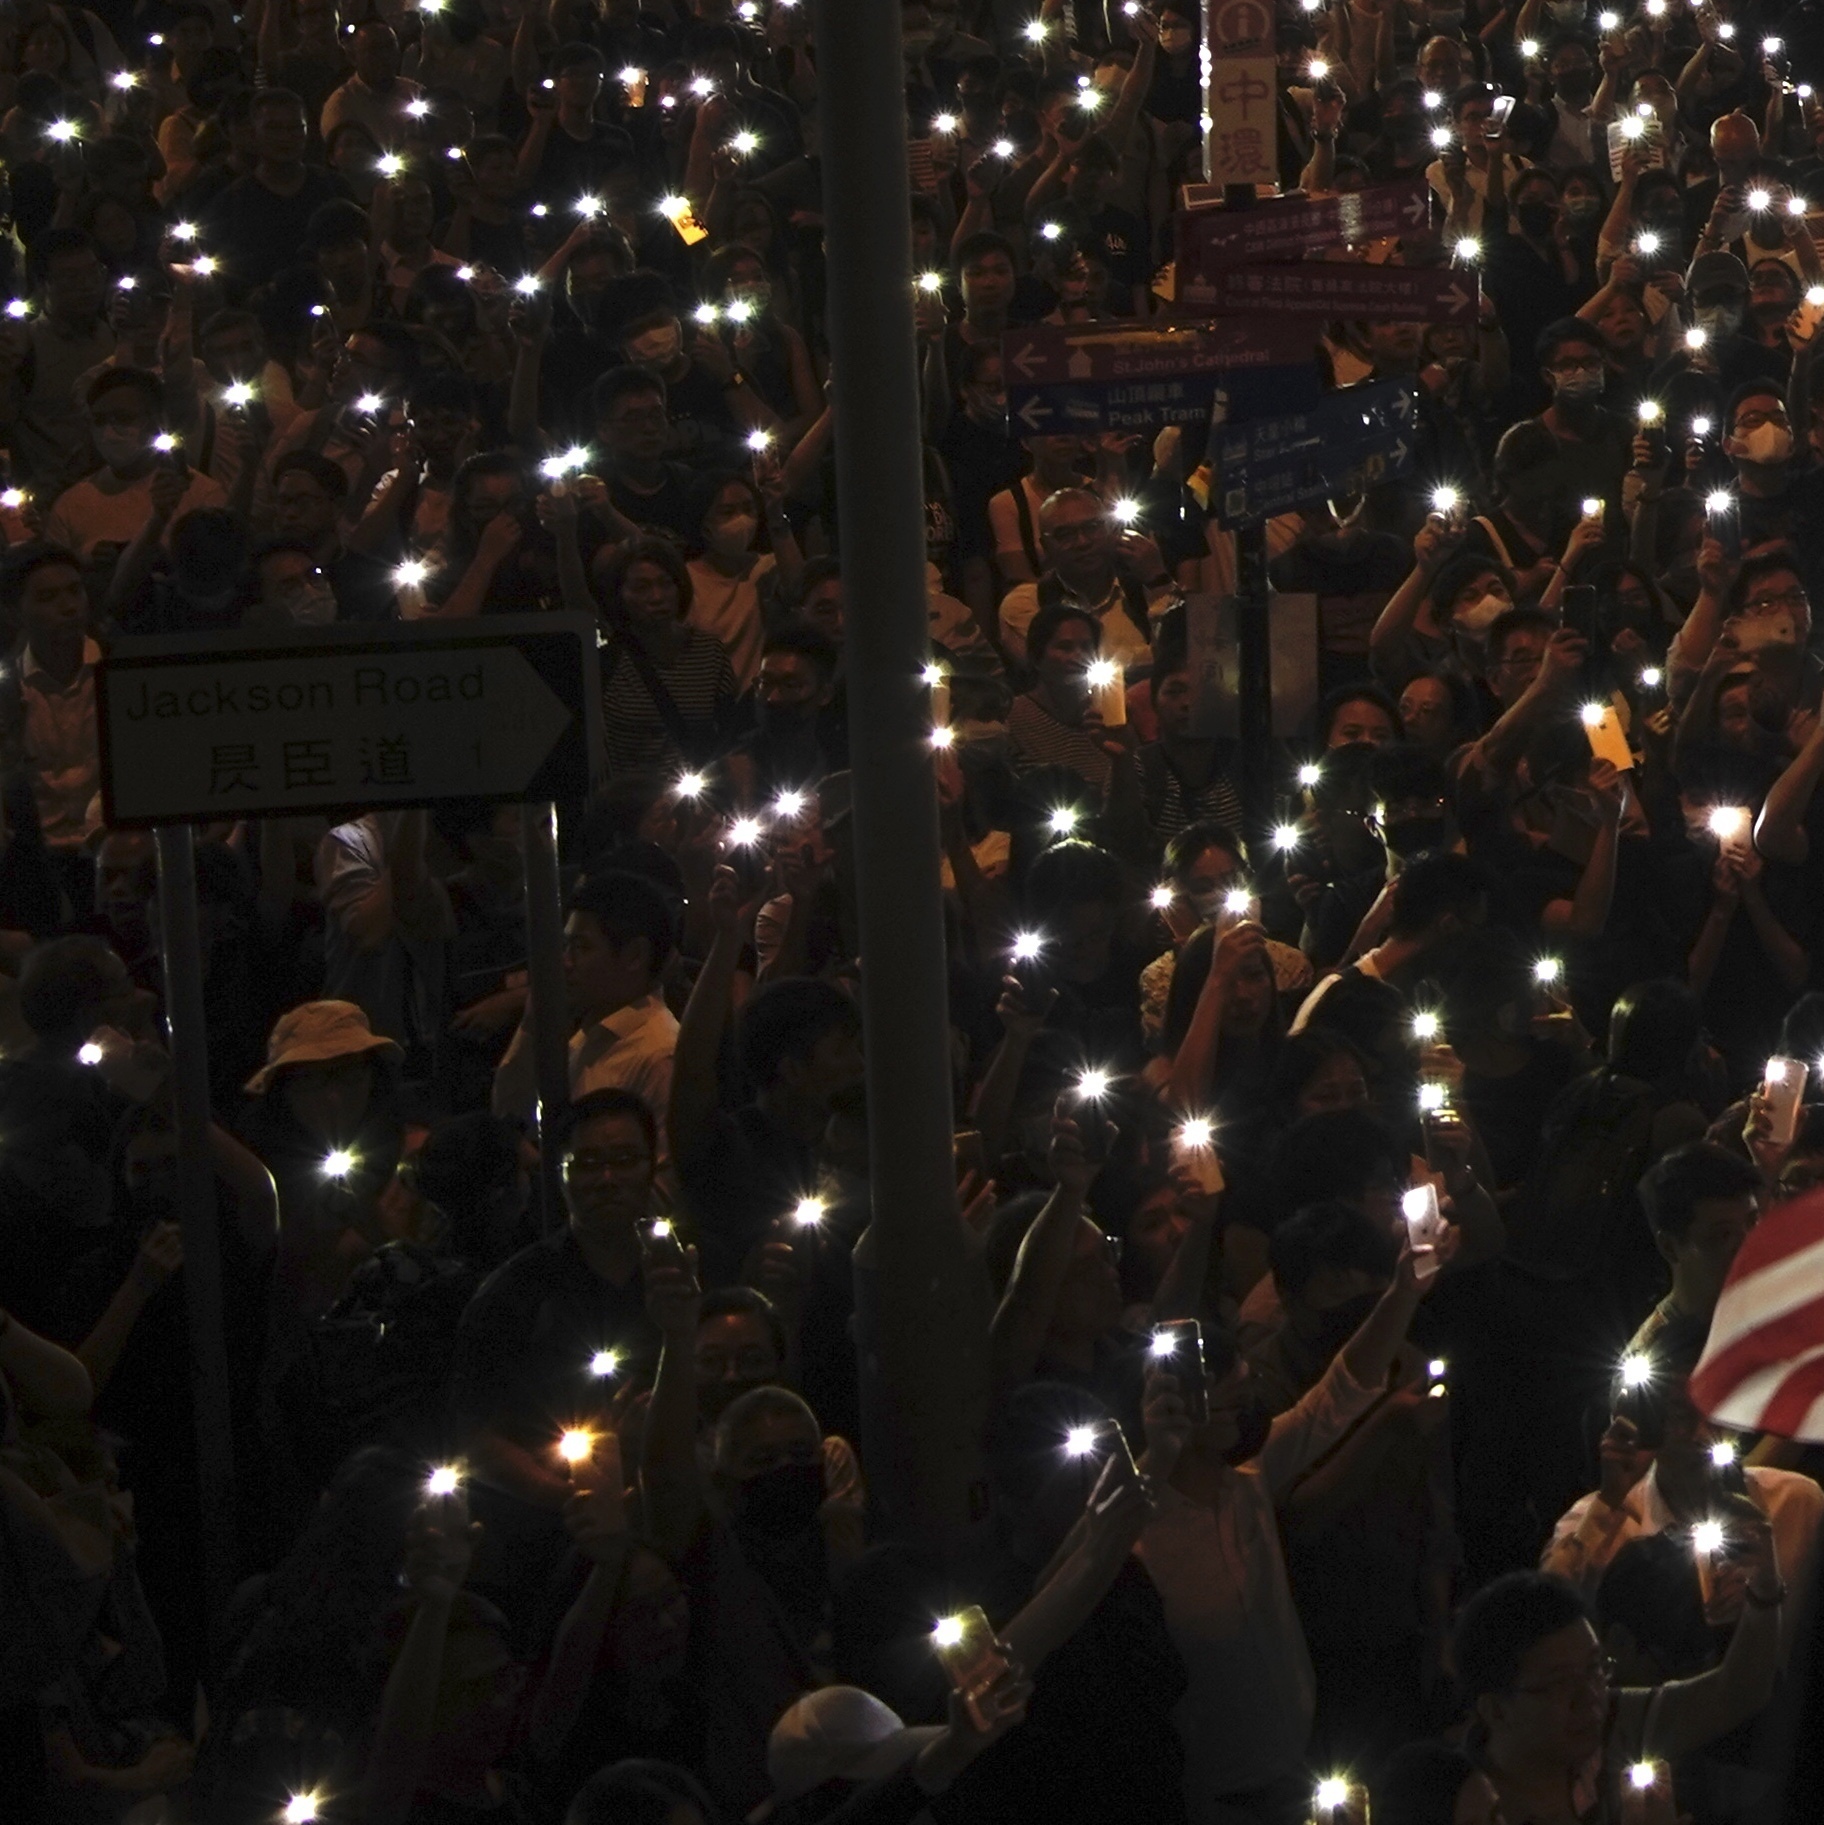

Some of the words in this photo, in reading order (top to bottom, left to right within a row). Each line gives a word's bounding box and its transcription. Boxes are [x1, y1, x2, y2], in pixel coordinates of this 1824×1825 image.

[1219, 68, 1270, 174] 中環
[1107, 409, 1154, 428] Peak
[1160, 405, 1206, 423] Tram
[126, 679, 335, 722] Jackson
[354, 664, 486, 708] Road
[208, 733, 417, 797] 昃臣道
